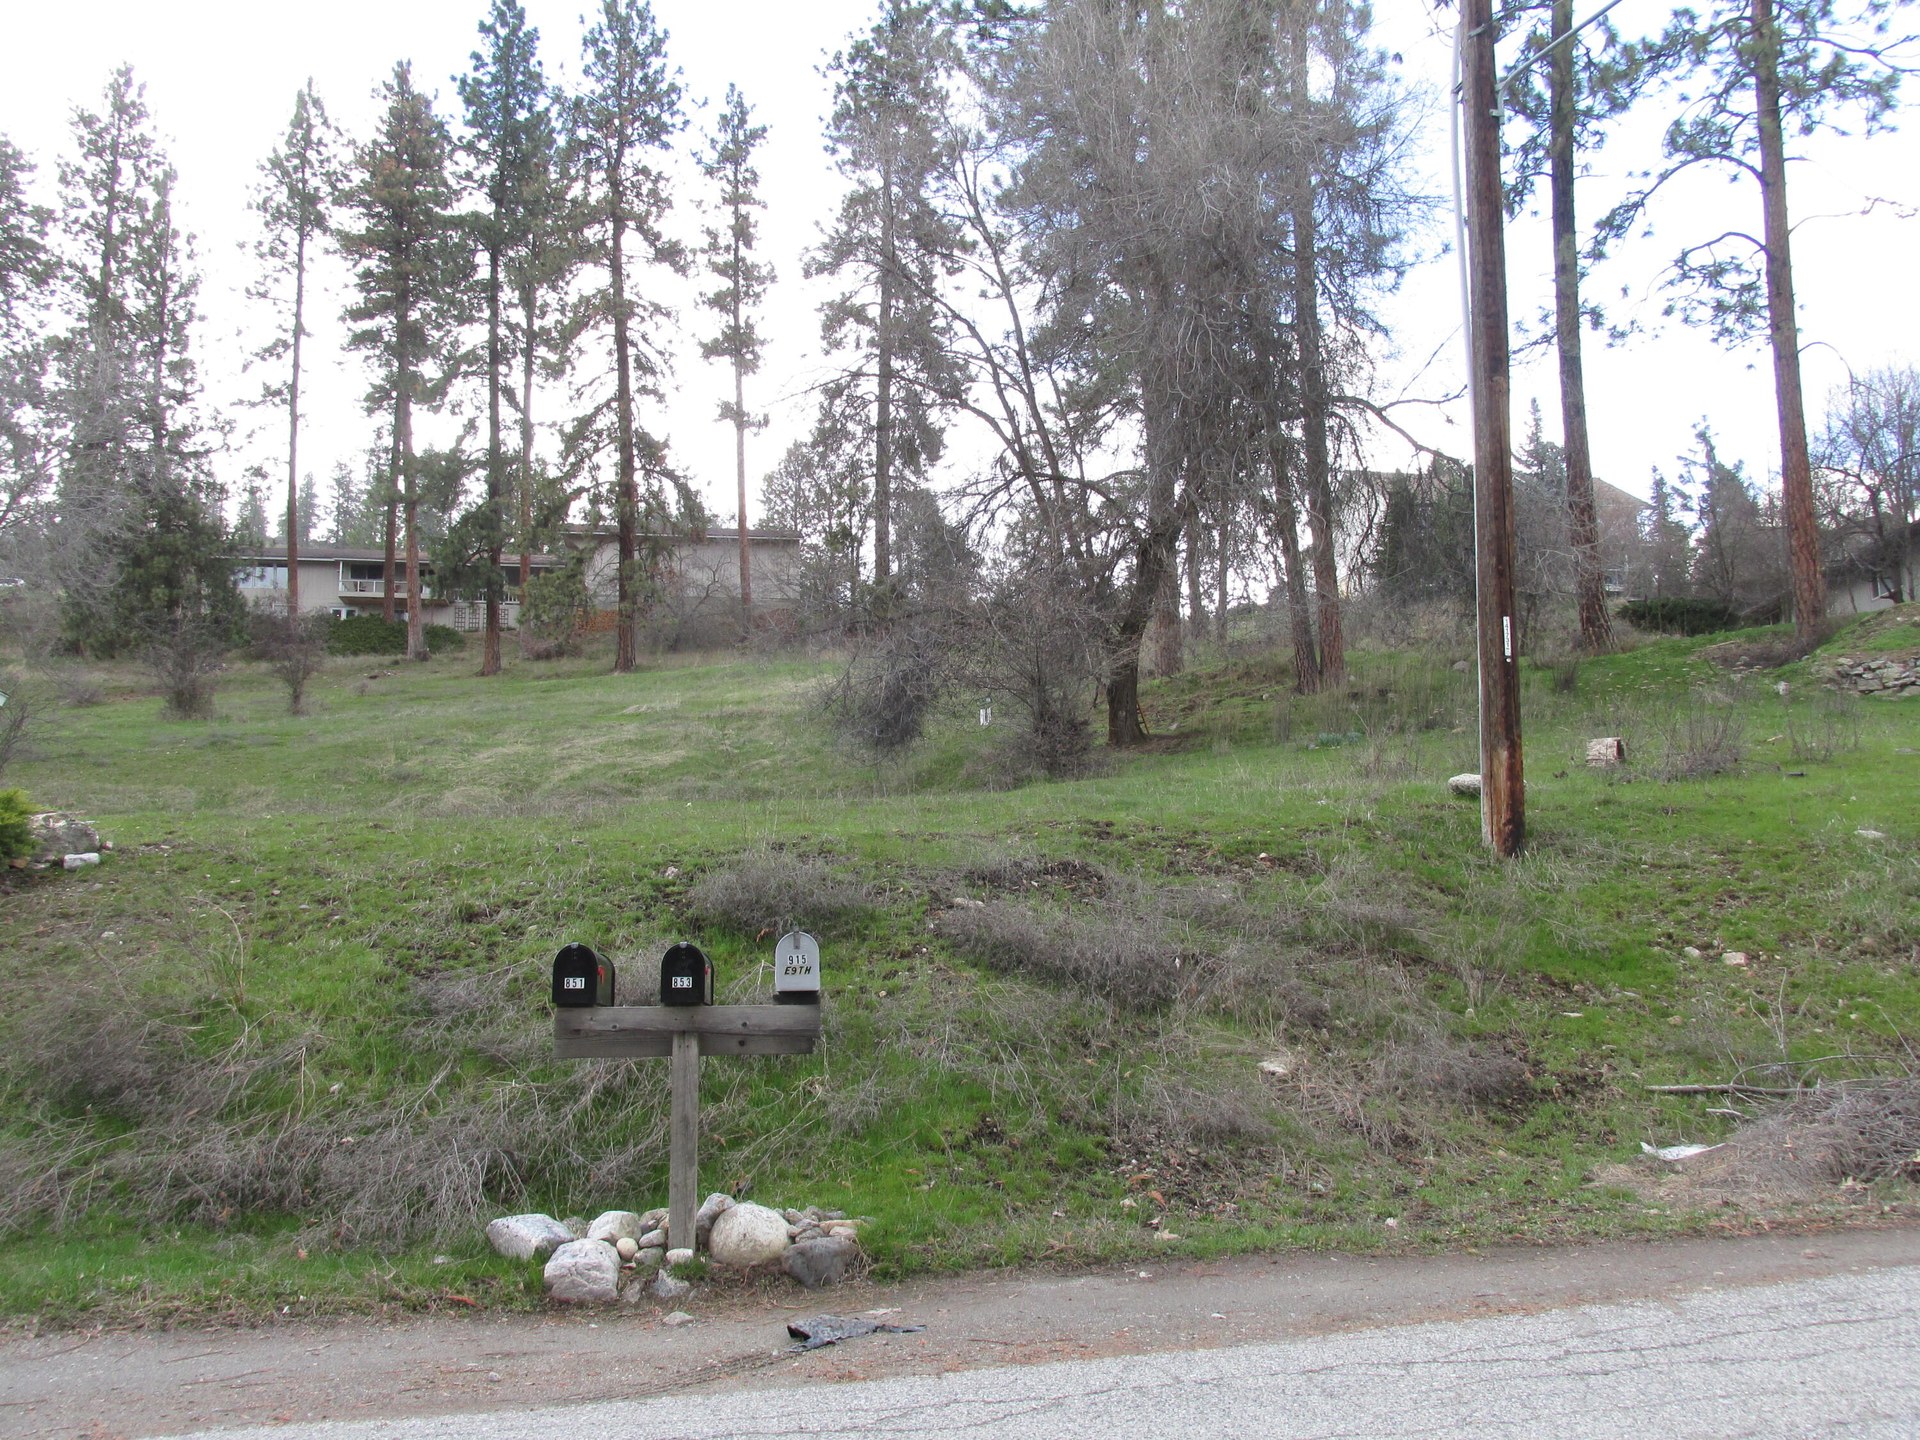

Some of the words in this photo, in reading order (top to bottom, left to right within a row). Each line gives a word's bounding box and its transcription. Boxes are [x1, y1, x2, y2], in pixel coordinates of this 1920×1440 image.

[788, 955, 807, 965] 915
[565, 978, 583, 988] 851
[673, 977, 691, 987] 853
